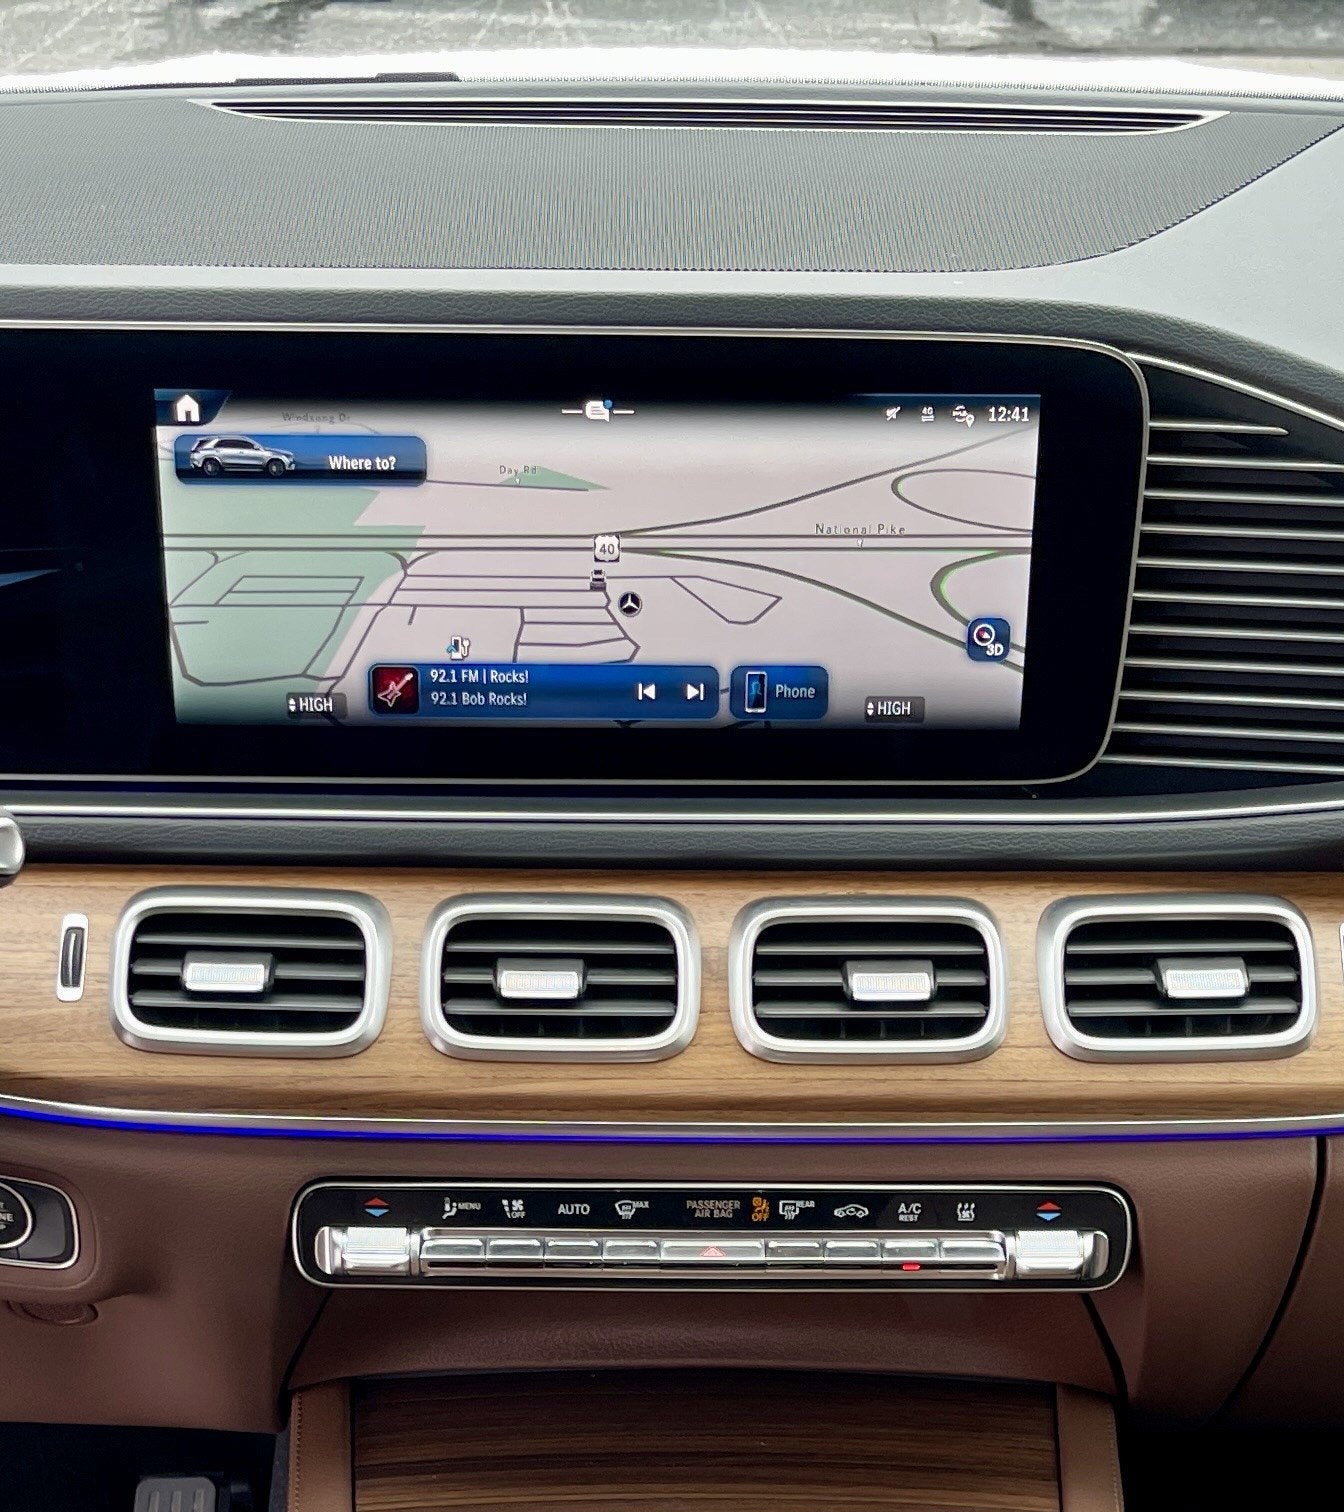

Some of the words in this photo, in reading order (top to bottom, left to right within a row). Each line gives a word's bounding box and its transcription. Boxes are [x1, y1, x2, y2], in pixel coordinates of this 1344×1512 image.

[988, 406, 1030, 422] 12:41
[328, 456, 373, 471] Where
[376, 456, 397, 471] to?
[499, 464, 519, 478] Day
[523, 464, 538, 476] Rd
[815, 523, 873, 536] National
[877, 523, 906, 536] Pike
[599, 543, 615, 555] 40
[986, 643, 1004, 657] 3D
[430, 669, 458, 684] 92.1
[461, 669, 480, 684] FM
[490, 669, 529, 684] Rocks!
[775, 684, 816, 698] Phone
[299, 698, 334, 713] HIGH
[430, 692, 458, 707] 92.1
[461, 692, 486, 707] Bob
[488, 692, 528, 707] Rocks!
[876, 701, 912, 716] HIGH
[458, 1202, 481, 1210] MENU
[557, 1203, 590, 1215] AUTO
[633, 1200, 649, 1209] MAX
[686, 1199, 741, 1211] PASSENGER
[796, 1200, 815, 1209] REAR
[897, 1202, 922, 1215] A/C
[510, 1210, 526, 1219] OFF
[694, 1208, 711, 1218] AIR
[713, 1208, 733, 1219] BAG
[751, 1211, 769, 1223] OFF
[898, 1214, 919, 1223] REST
